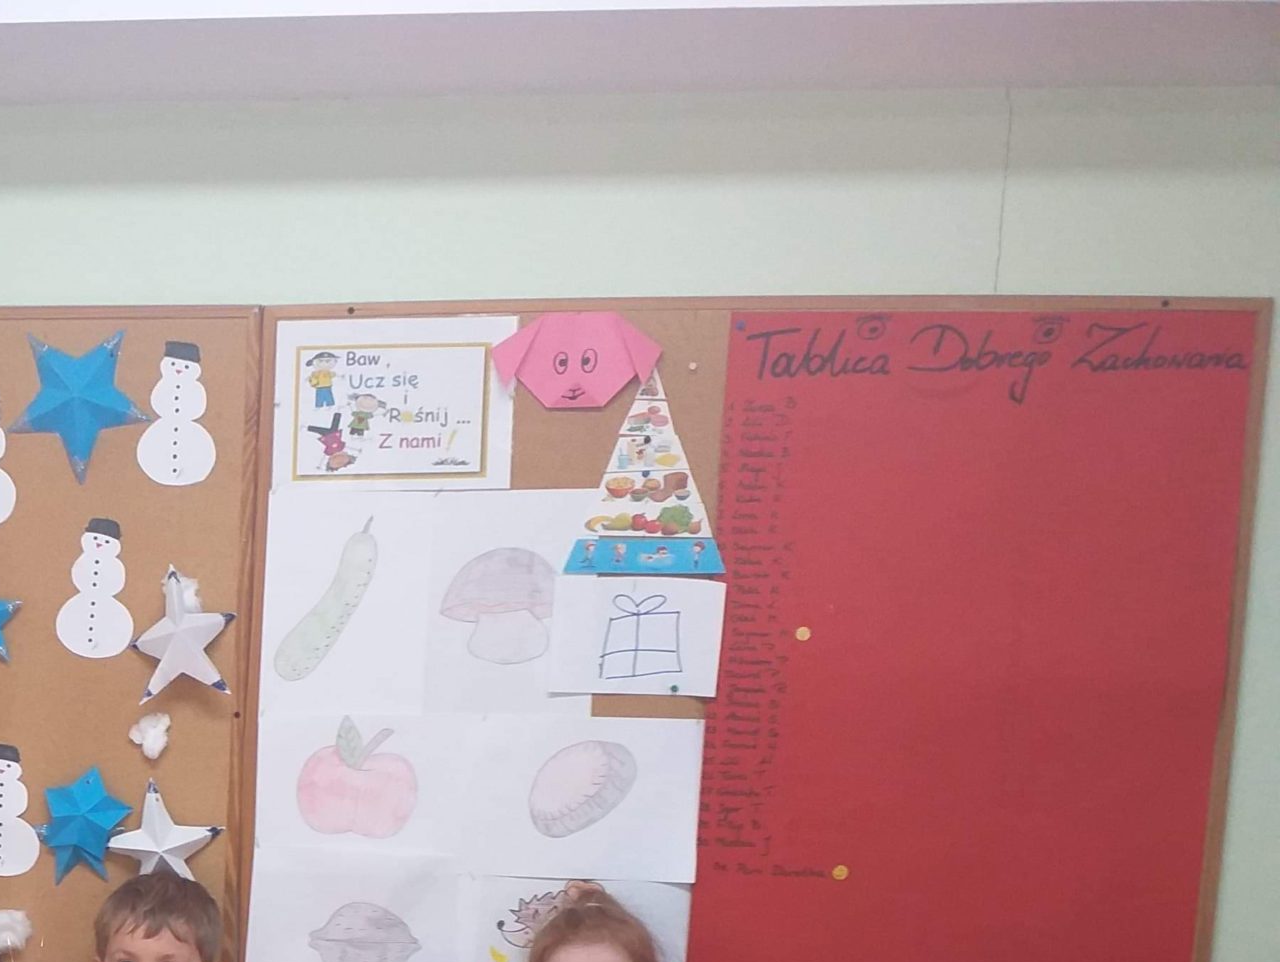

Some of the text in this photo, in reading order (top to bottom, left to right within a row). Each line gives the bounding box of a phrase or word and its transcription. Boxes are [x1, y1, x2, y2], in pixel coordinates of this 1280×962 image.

[345, 350, 381, 367] Baw
[746, 327, 892, 381] Tablica
[905, 323, 1053, 405] Dobrego
[348, 370, 420, 390] Ucz się
[403, 389, 409, 405] i
[378, 433, 393, 449] Z
[398, 432, 442, 449] nami
